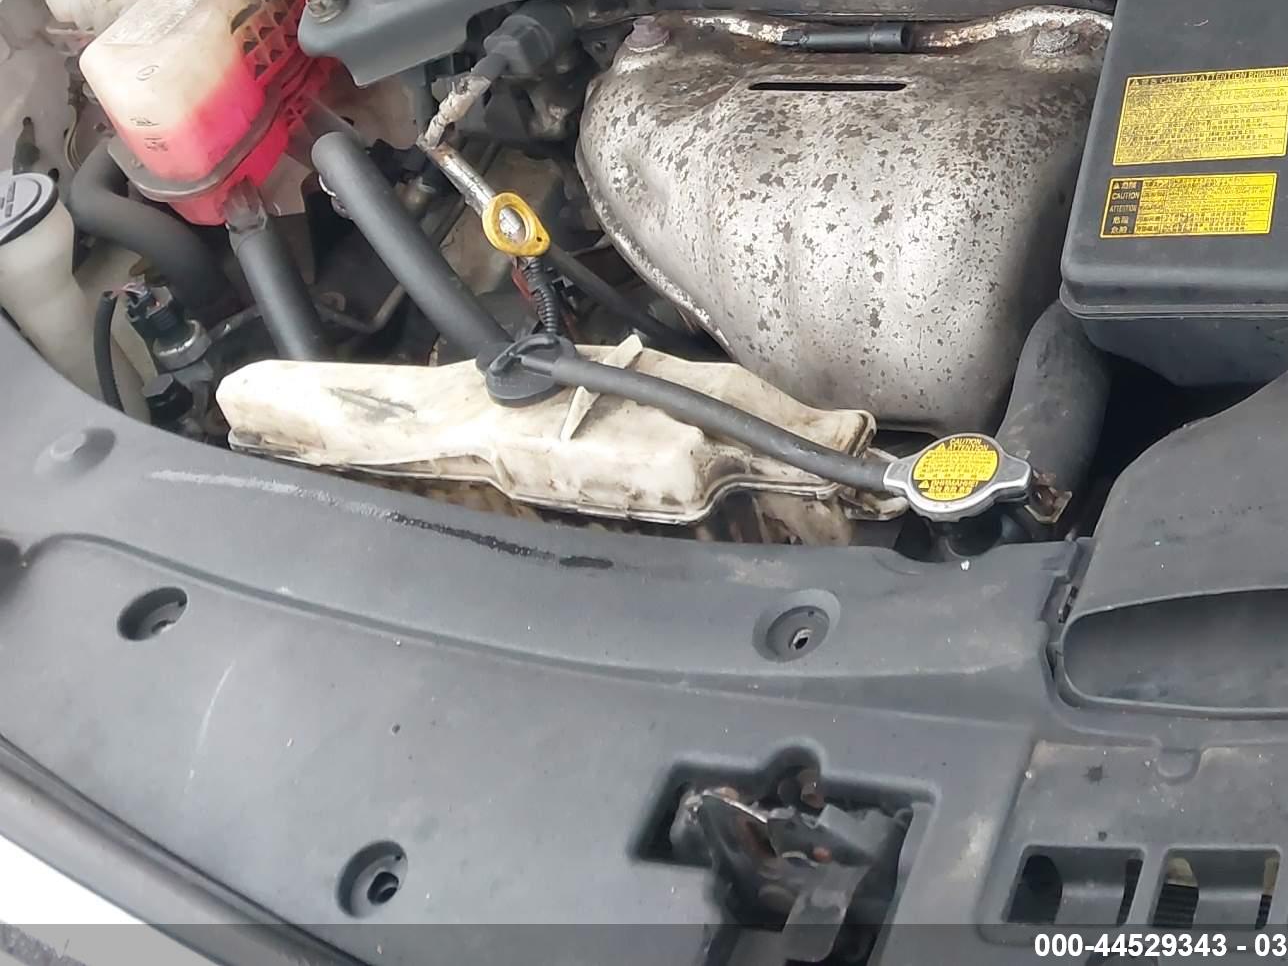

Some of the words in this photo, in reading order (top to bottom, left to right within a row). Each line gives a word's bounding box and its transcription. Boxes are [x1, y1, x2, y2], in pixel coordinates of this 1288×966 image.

[1160, 74, 1197, 84] CAUTION
[1200, 70, 1246, 81] ATTENTION
[1112, 192, 1140, 200] CAUTION
[1109, 204, 1137, 213] ATTENTION
[949, 437, 982, 445] CAUTION
